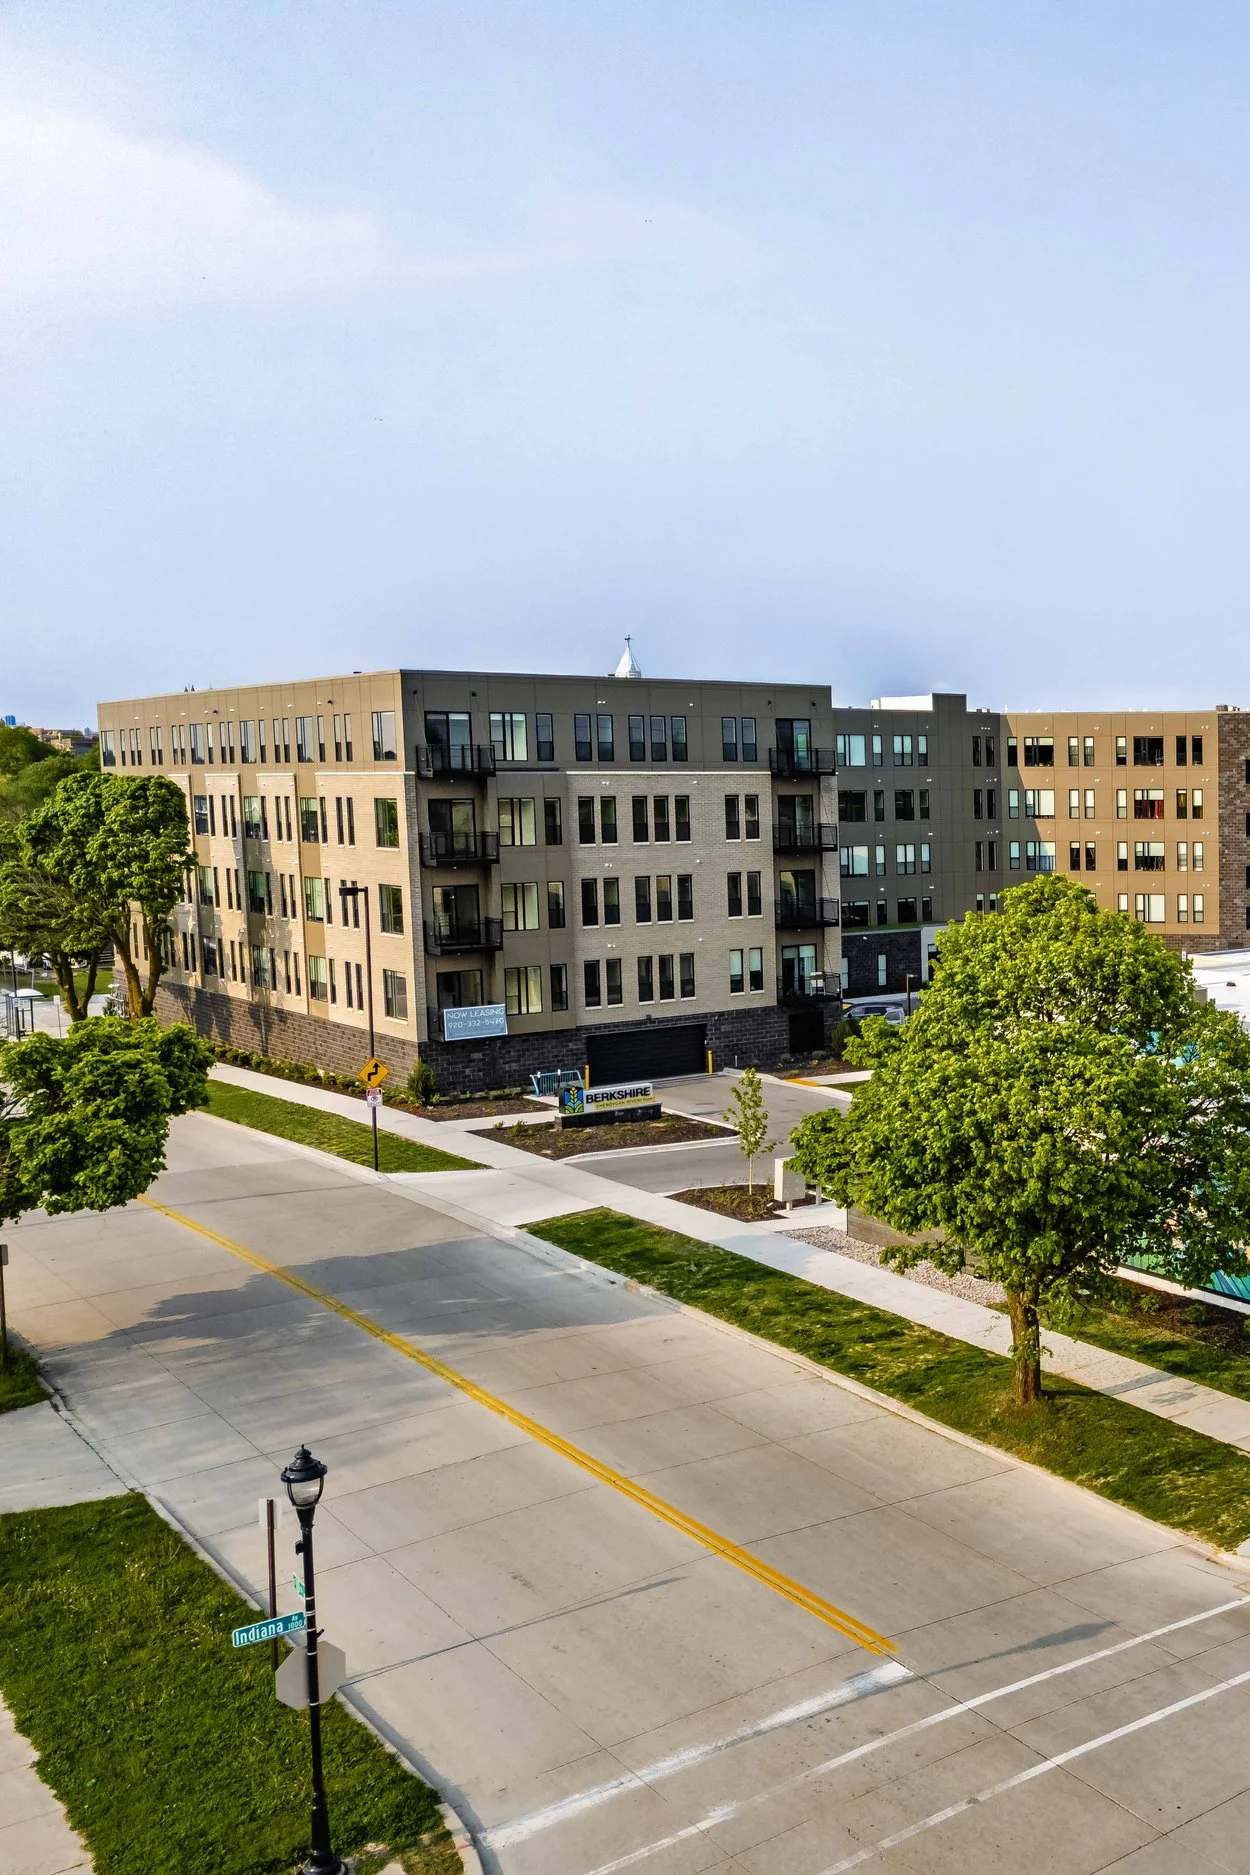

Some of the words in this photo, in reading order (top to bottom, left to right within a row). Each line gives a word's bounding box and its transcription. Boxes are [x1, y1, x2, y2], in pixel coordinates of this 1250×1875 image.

[447, 1011, 467, 1019] NOW
[470, 1008, 505, 1018] LEASING
[448, 1018, 504, 1028] 920-332-5470
[585, 1087, 650, 1104] BERKSHIRE
[288, 1620, 302, 1629] 1000
[235, 1622, 283, 1646] Indiana
